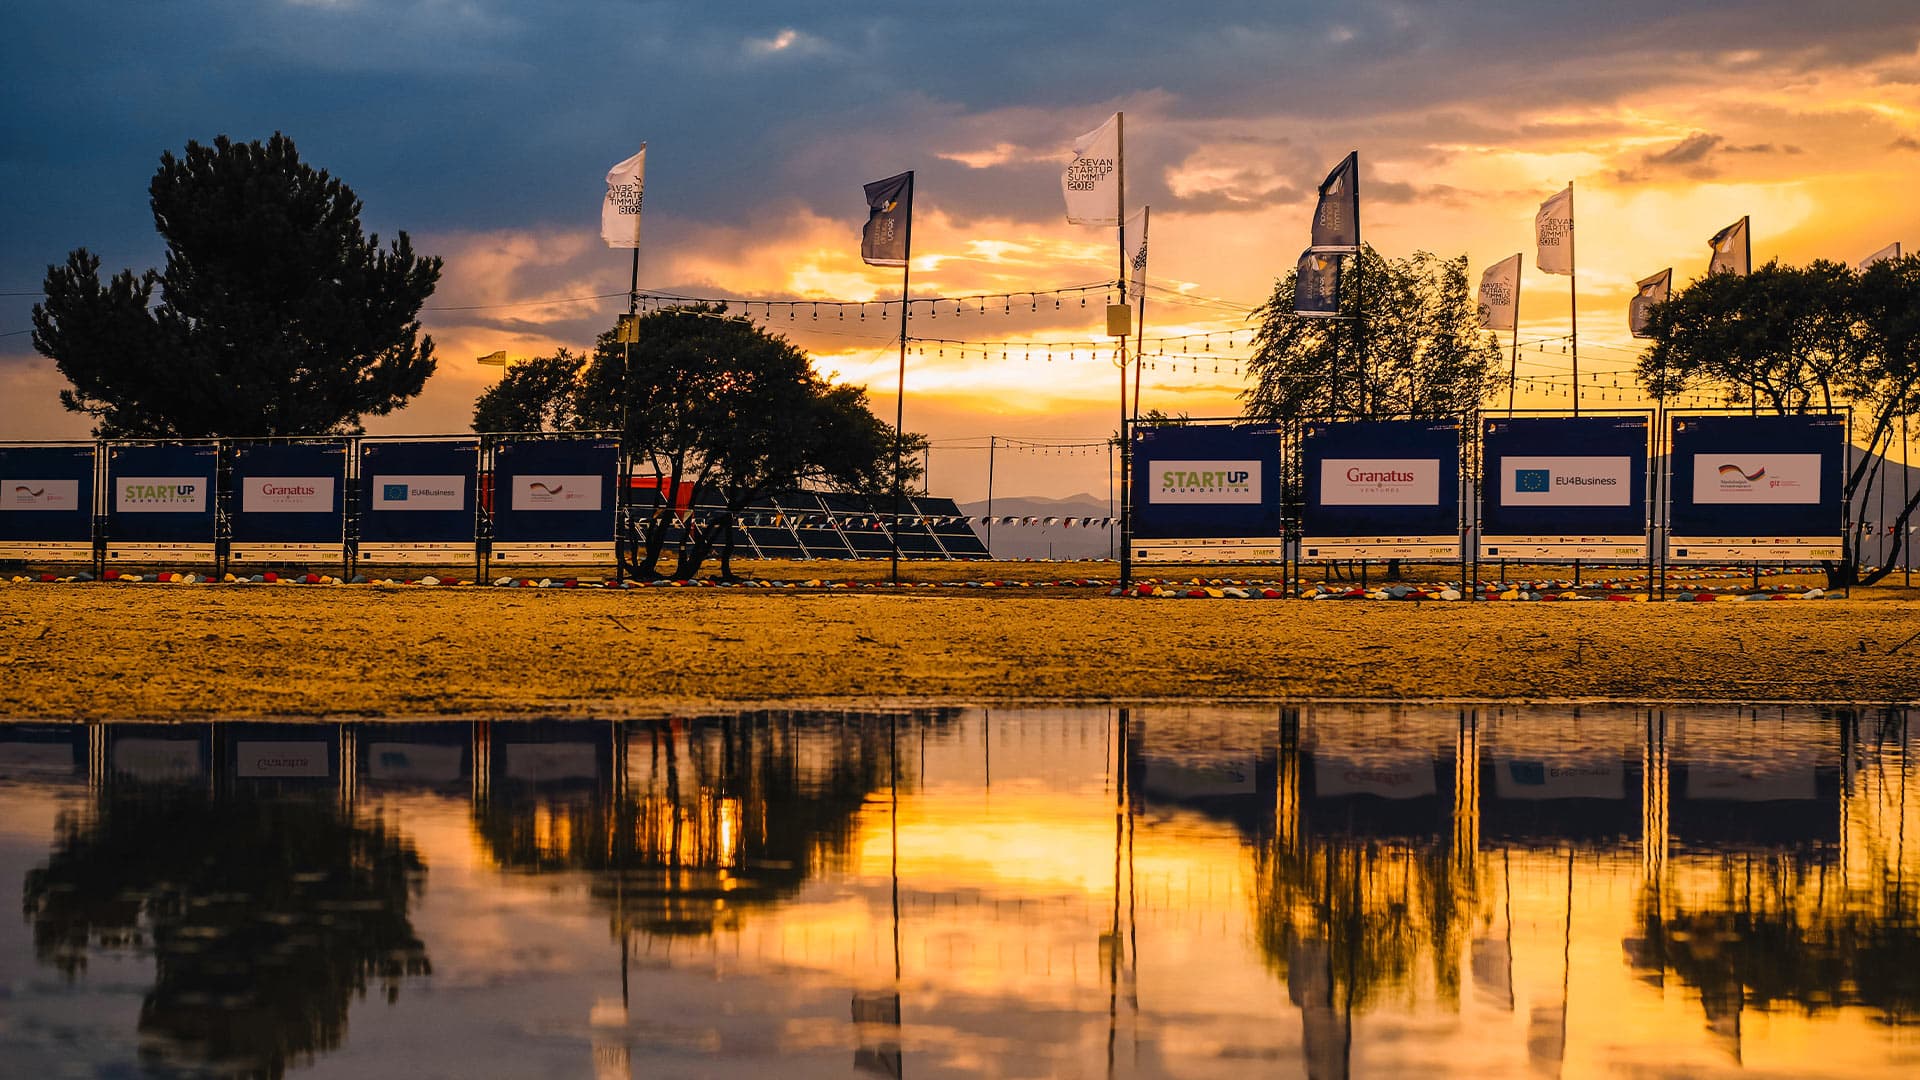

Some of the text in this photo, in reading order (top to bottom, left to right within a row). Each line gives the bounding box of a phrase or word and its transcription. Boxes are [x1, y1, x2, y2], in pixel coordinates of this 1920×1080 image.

[1080, 158, 1113, 167] SEVAN
[1067, 166, 1113, 174] STARTUP
[1067, 173, 1105, 181] SUMMIT
[1067, 181, 1095, 191] 2018
[1540, 224, 1574, 232] STARTUP
[1163, 471, 1249, 488] STARTUP
[1346, 467, 1414, 482] Granatus
[1555, 476, 1617, 486] EU4Business
[126, 485, 195, 499] STARTUP
[262, 483, 315, 496] Granatus
[411, 488, 456, 497] EU4Business
